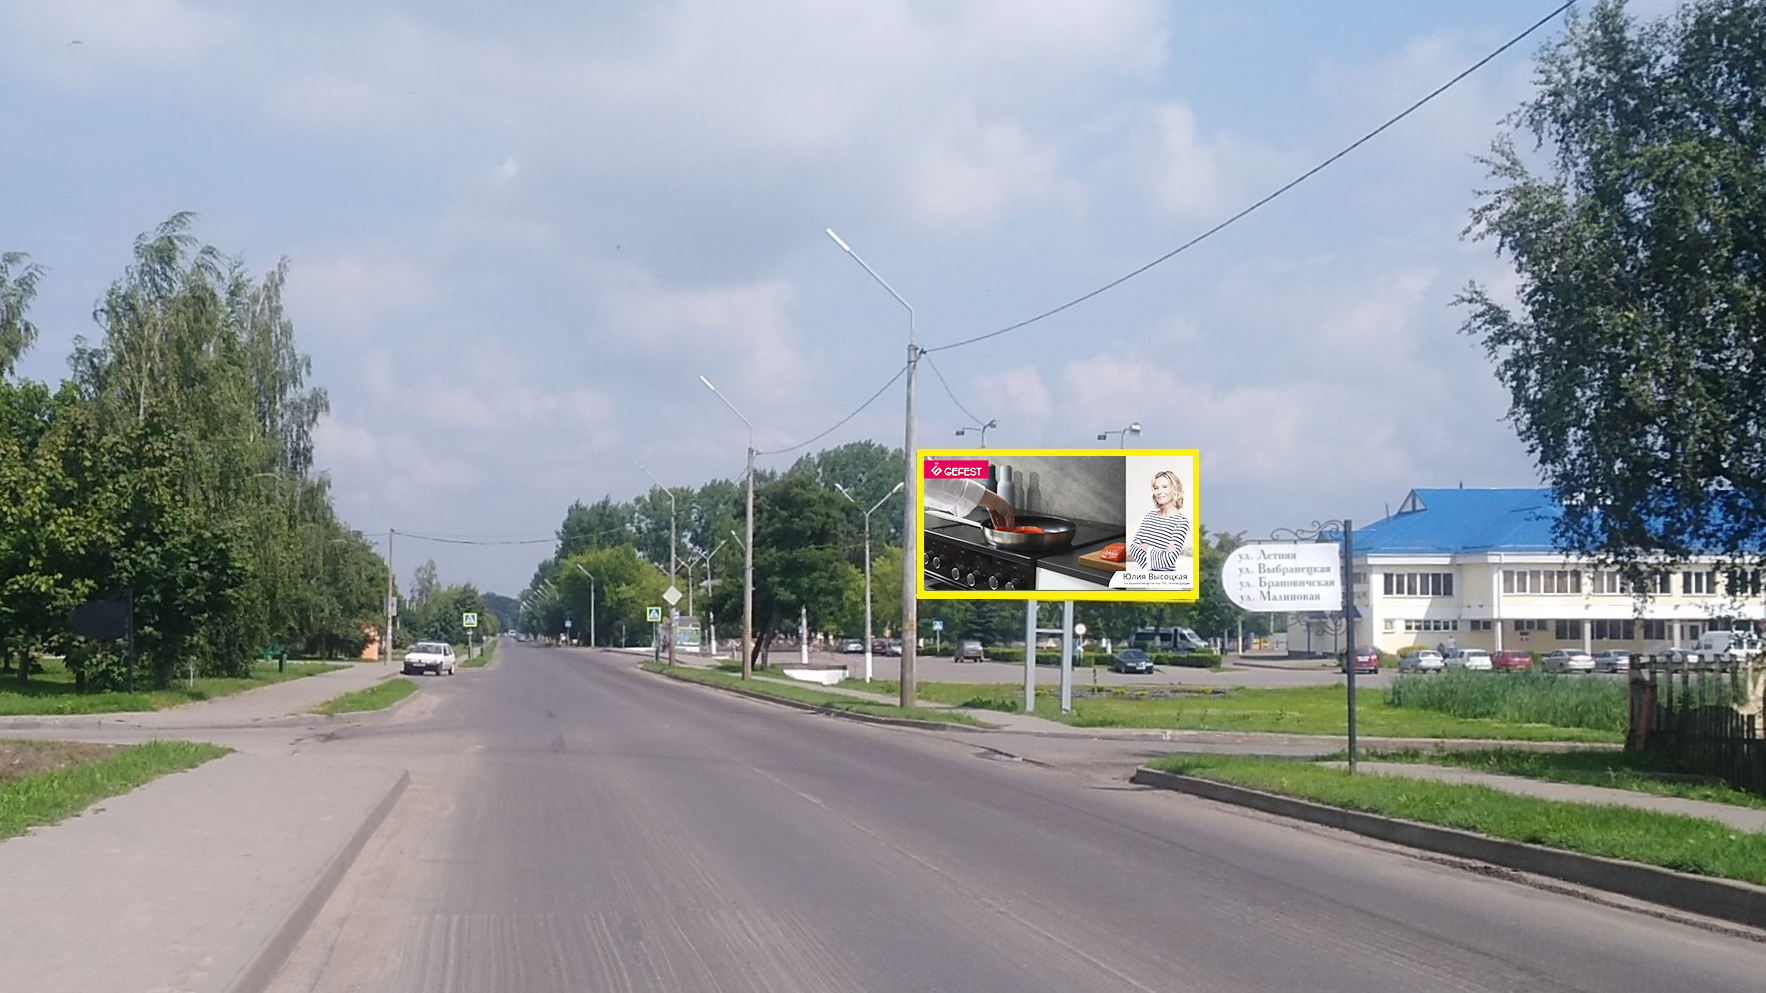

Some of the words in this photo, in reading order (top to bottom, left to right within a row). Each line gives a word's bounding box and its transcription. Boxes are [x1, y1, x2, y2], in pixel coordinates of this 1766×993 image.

[944, 467, 982, 476] GEFEST
[1238, 553, 1253, 563] ул.
[1257, 549, 1297, 560] Летняя
[1149, 573, 1187, 581] Высоцкая
[1238, 567, 1254, 577] ул.
[1258, 563, 1331, 575] Выбранецкая
[1239, 581, 1254, 591] ул.
[1258, 577, 1335, 590] Брановичская
[1239, 595, 1255, 604] ул.
[1259, 590, 1321, 601] Малиновая
